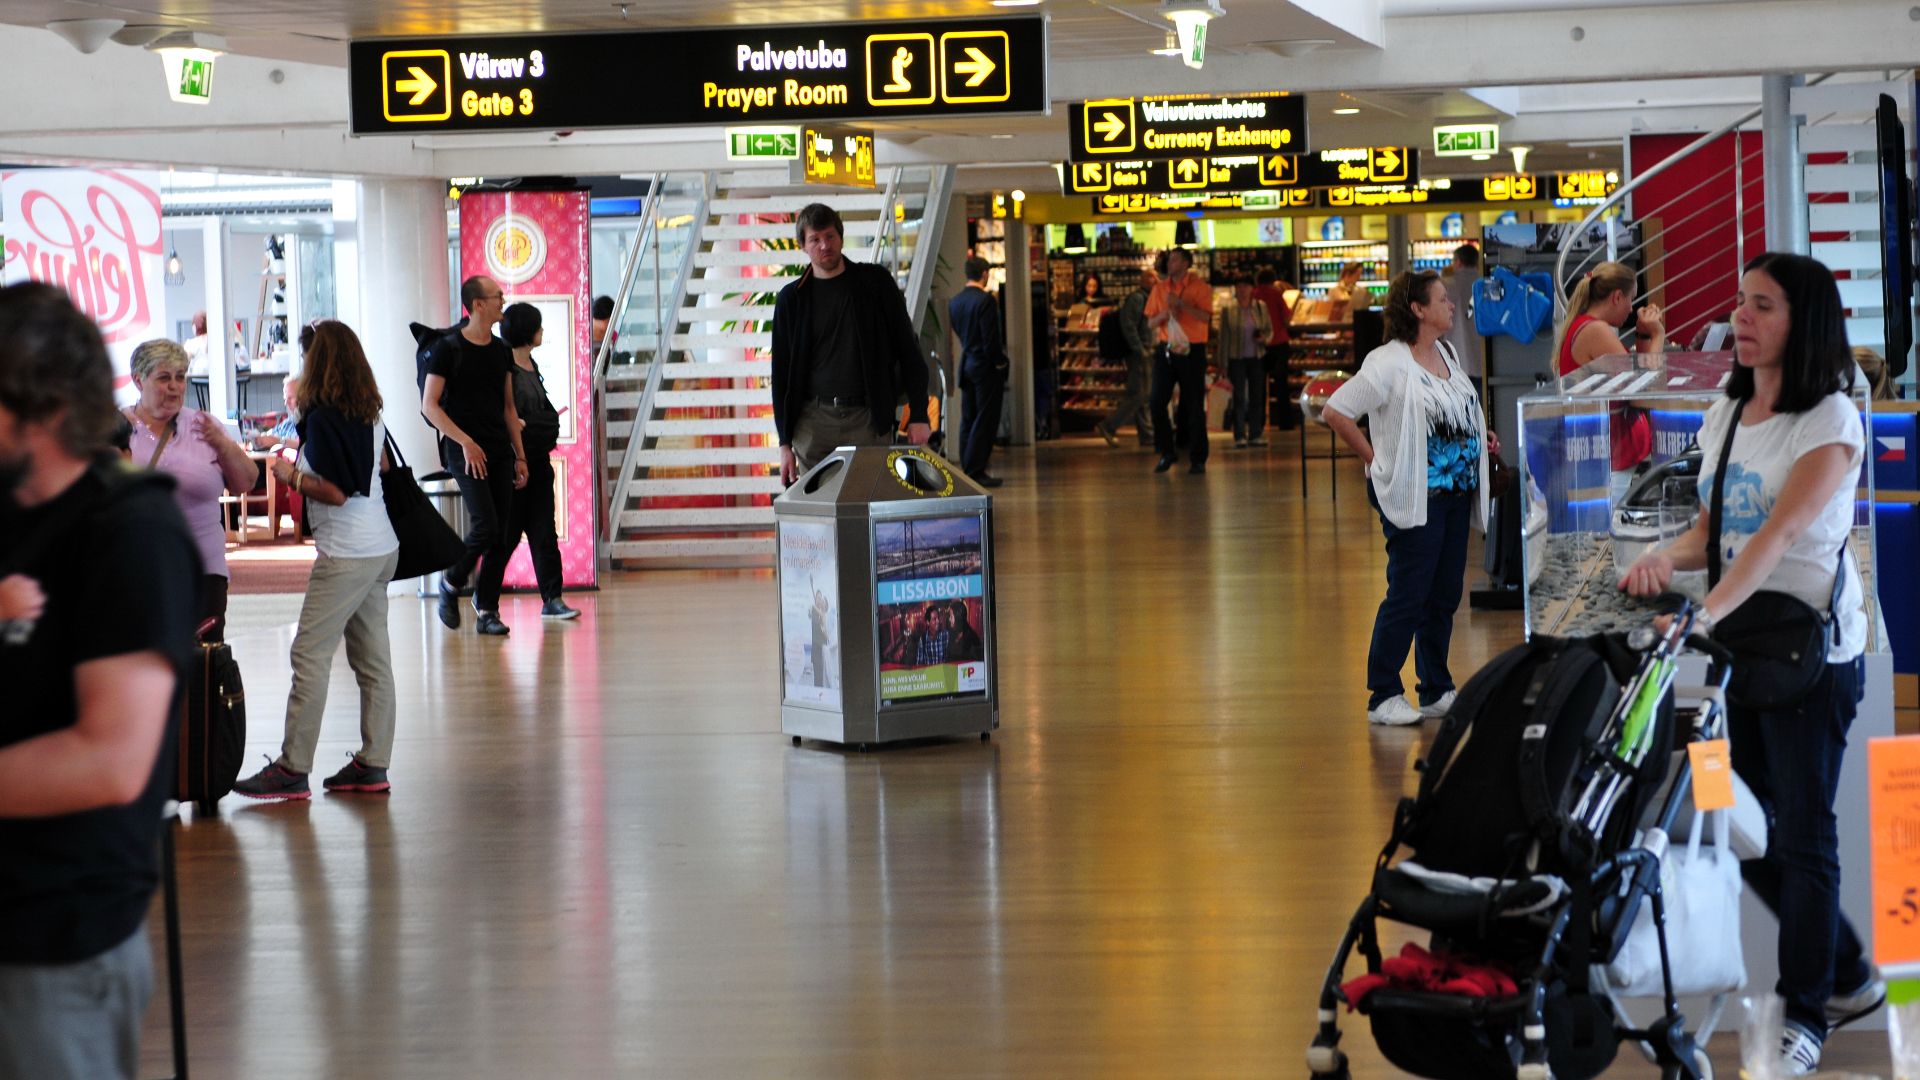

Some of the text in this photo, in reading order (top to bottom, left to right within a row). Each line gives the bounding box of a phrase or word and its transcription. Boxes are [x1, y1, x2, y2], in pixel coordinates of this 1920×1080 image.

[459, 50, 545, 79] Värav 3
[736, 40, 847, 71] Palvetuba
[460, 88, 534, 116] Gate 3
[703, 79, 848, 113] Prayer Room
[1141, 98, 1267, 122] Valuutavahetus
[1143, 125, 1292, 151] Currency Exchange
[1113, 170, 1146, 185] Gate 1
[1210, 167, 1230, 182] Exit
[1338, 163, 1368, 181] Shop
[892, 578, 969, 602] LISSABON
